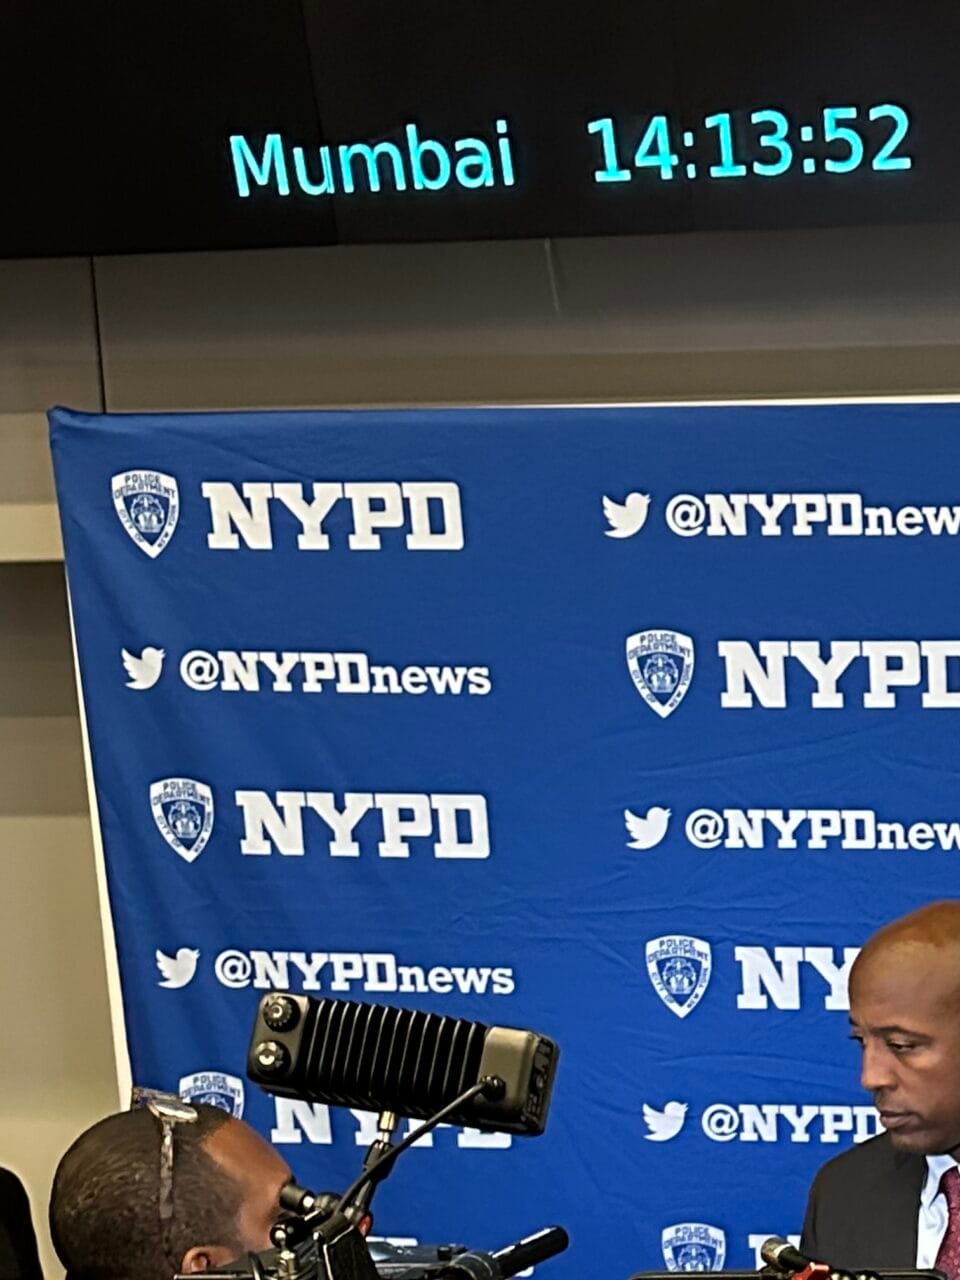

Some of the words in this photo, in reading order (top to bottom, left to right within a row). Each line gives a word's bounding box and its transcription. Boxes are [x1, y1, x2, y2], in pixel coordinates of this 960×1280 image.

[230, 121, 514, 198] Mumbai
[588, 105, 911, 183] 14:13:52
[202, 482, 464, 550] NYPD
[640, 633, 675, 643] POLICE
[180, 651, 491, 694] @NYPDnews
[236, 791, 490, 858] NYPD
[215, 950, 514, 994] @NYPDnews
[735, 947, 861, 1010] NY
[702, 1104, 886, 1143] @NYPD
